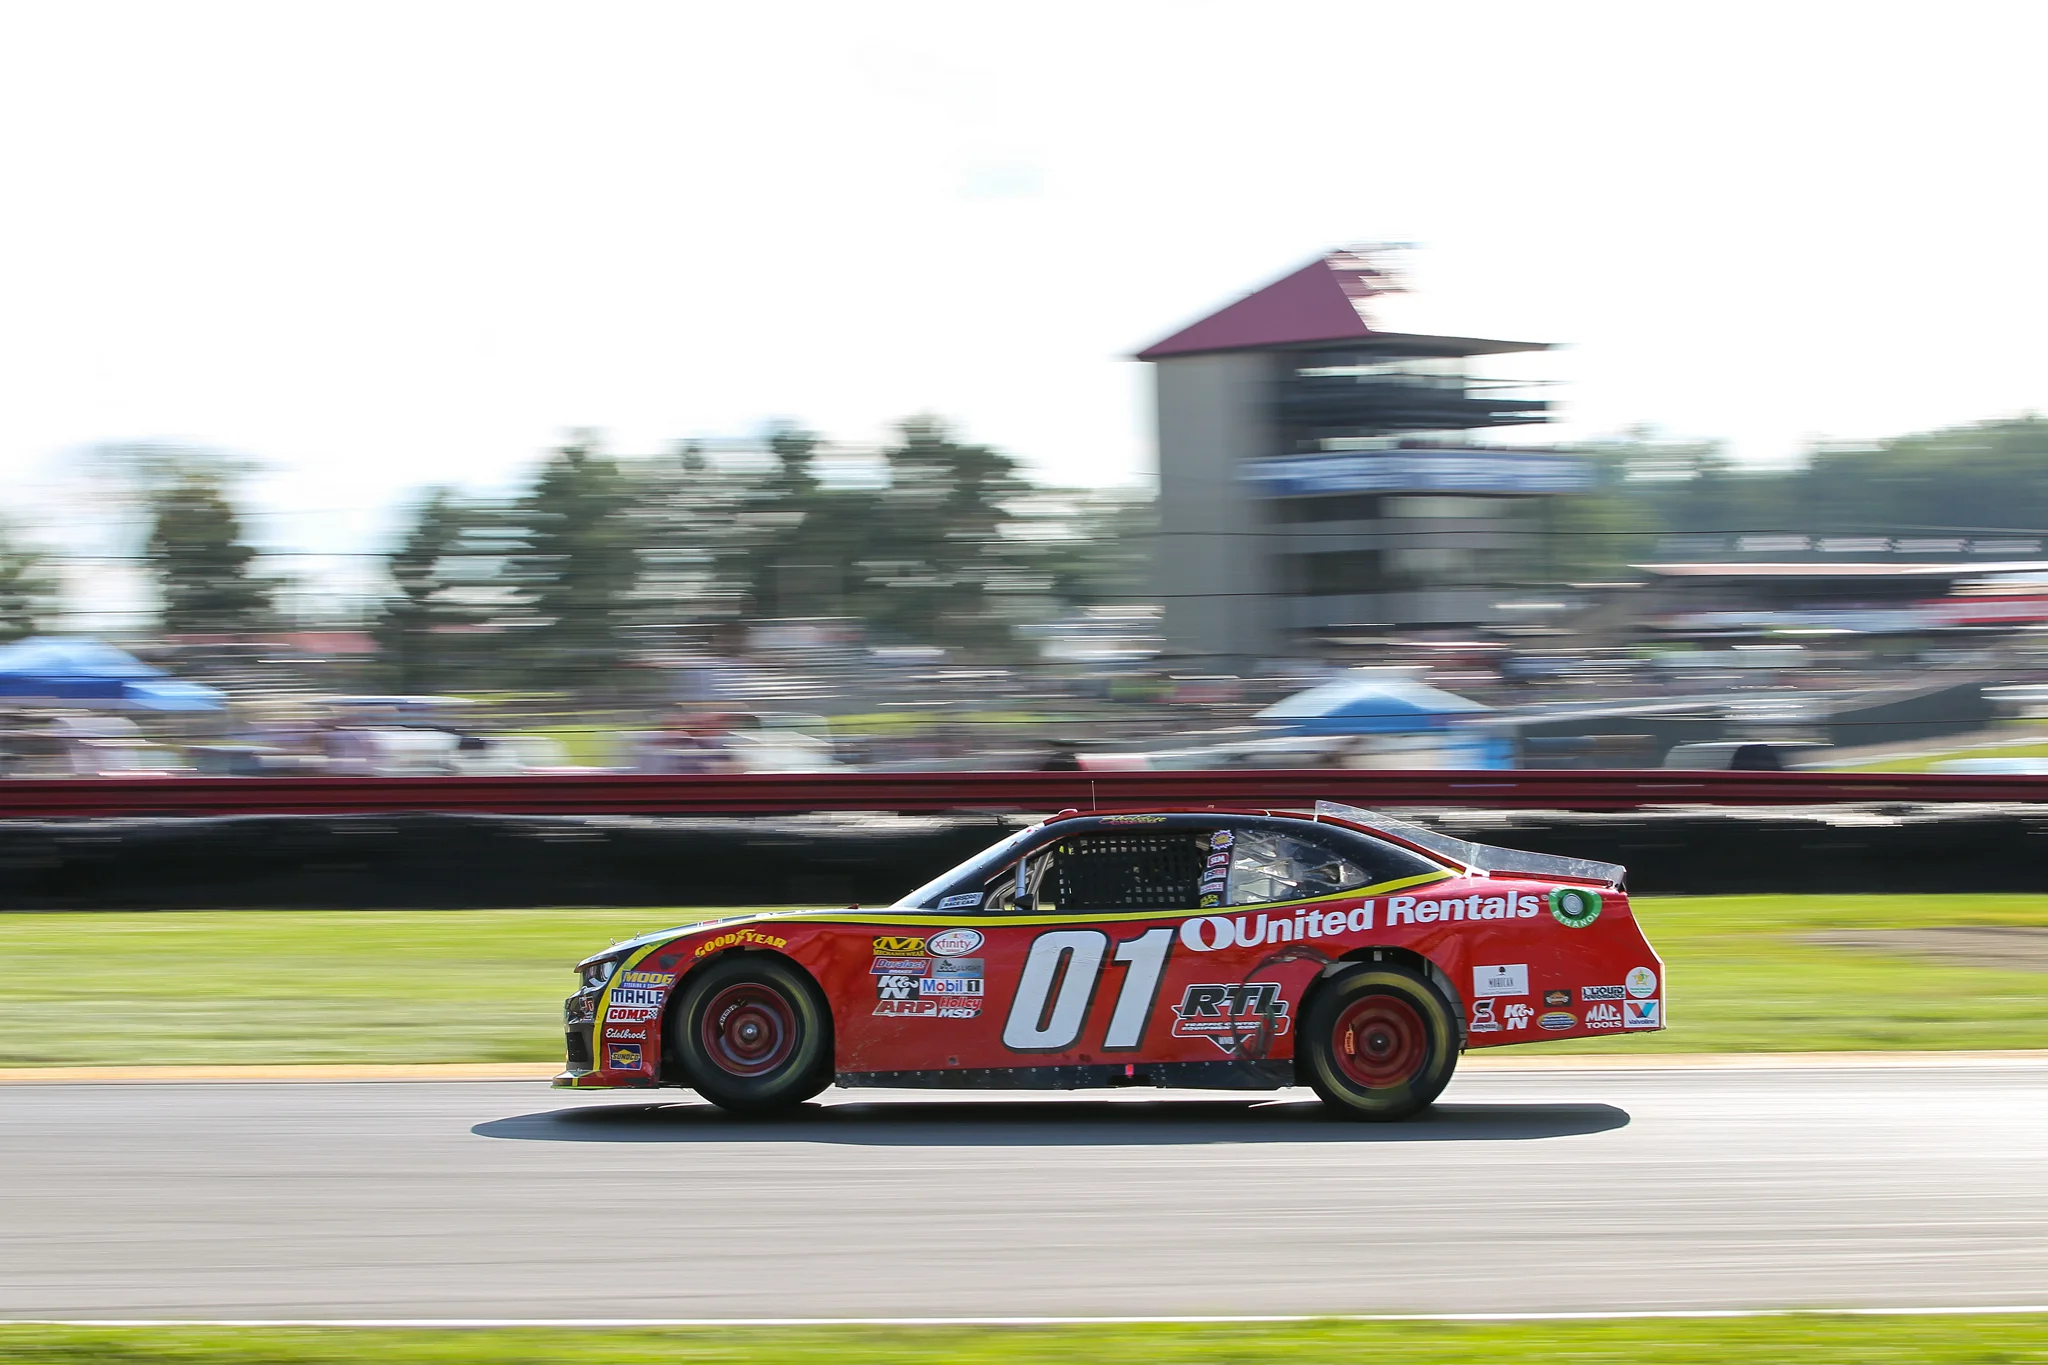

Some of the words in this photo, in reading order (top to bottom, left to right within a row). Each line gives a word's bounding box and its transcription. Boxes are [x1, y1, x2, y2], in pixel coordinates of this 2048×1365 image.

[1235, 900, 1375, 947] United
[1386, 891, 1540, 926] Rentals
[1552, 910, 1600, 928] ETHANOL
[695, 929, 787, 957] GOODYEAR
[935, 938, 971, 950] xfinity
[623, 972, 675, 984] MOOG
[923, 979, 963, 992] Mobil
[970, 980, 977, 992] 1
[1002, 928, 1176, 1051] 01
[874, 1001, 936, 1014] ARP
[1180, 985, 1286, 1017] RTL
[610, 1009, 649, 1020] COMP
[938, 1009, 976, 1018] MSD
[1585, 1003, 1622, 1021] MAC
[1585, 1021, 1622, 1029] TOOLS
[606, 1028, 647, 1040] Edelbrock
